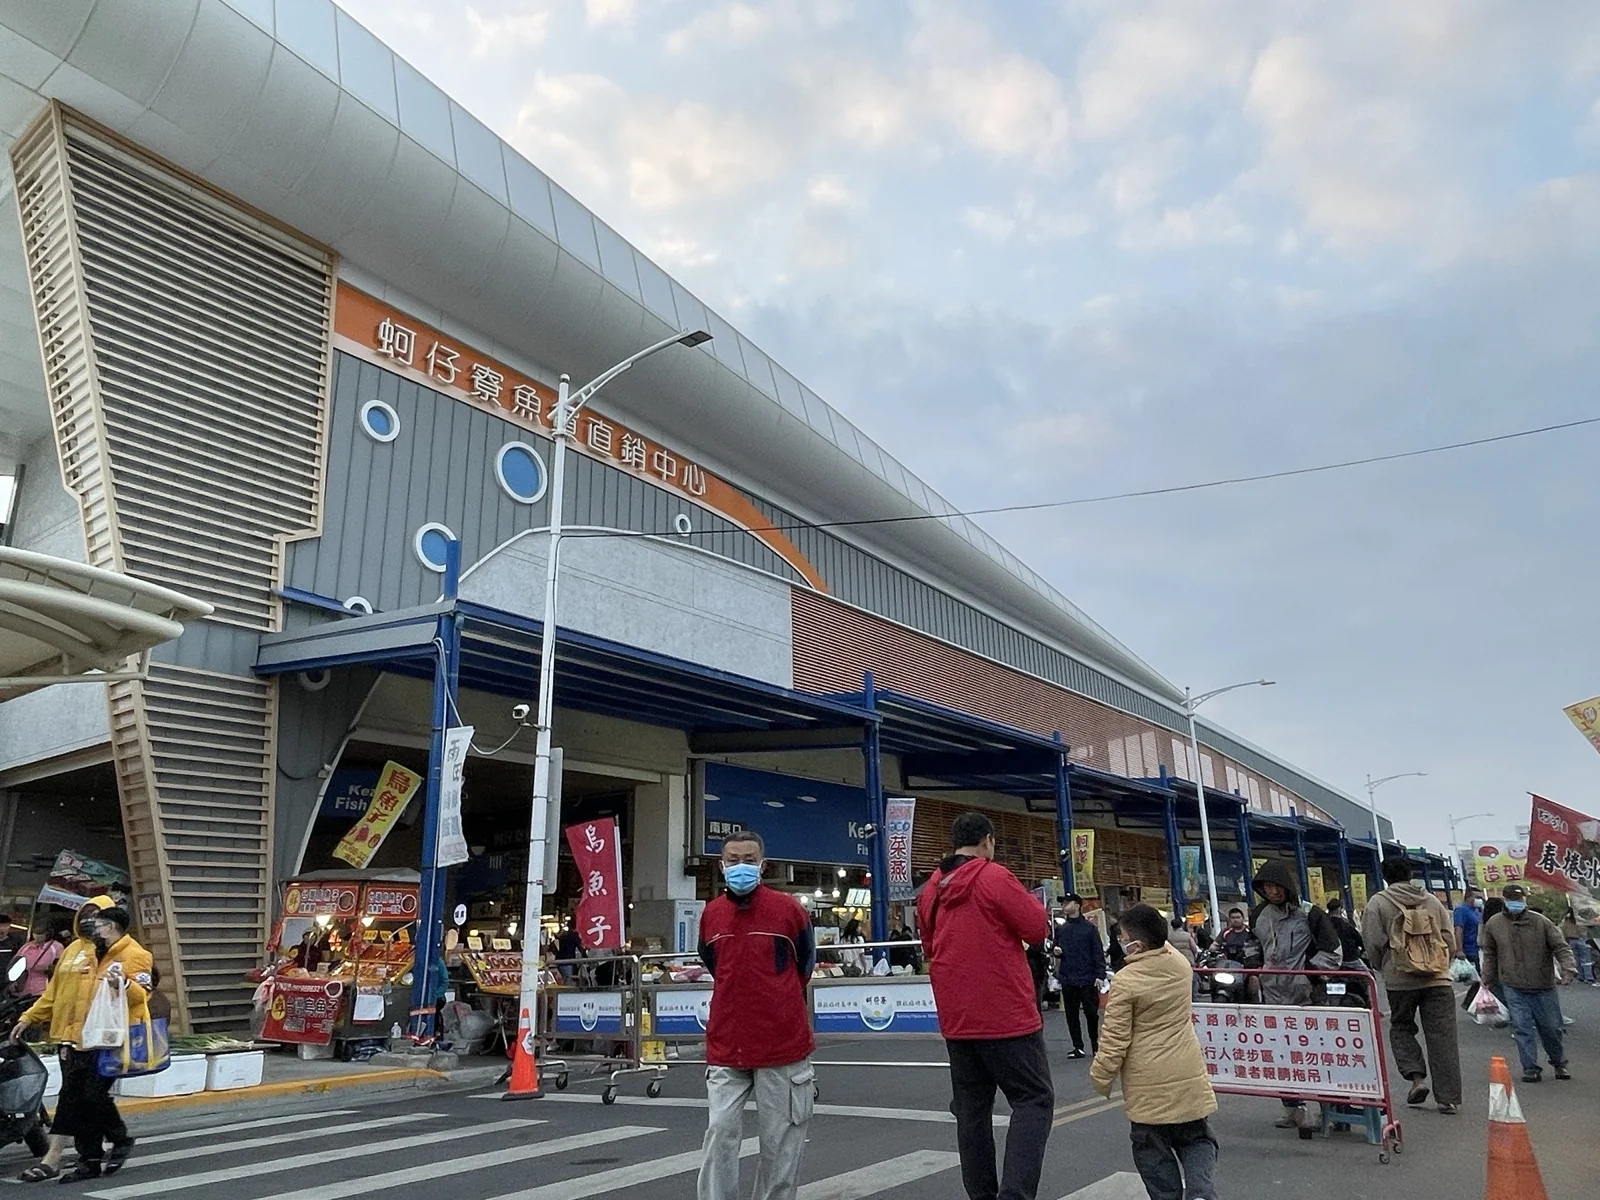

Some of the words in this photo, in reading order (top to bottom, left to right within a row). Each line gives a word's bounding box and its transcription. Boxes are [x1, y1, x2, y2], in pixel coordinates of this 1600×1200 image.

[335, 797, 367, 811] Fish
[1482, 863, 1522, 883] 造型
[585, 824, 612, 946] 烏魚子
[1191, 1013, 1361, 1032] 本路段於國定例假日
[1201, 1046, 1367, 1068] 行人徒步區，請勿停放汽
